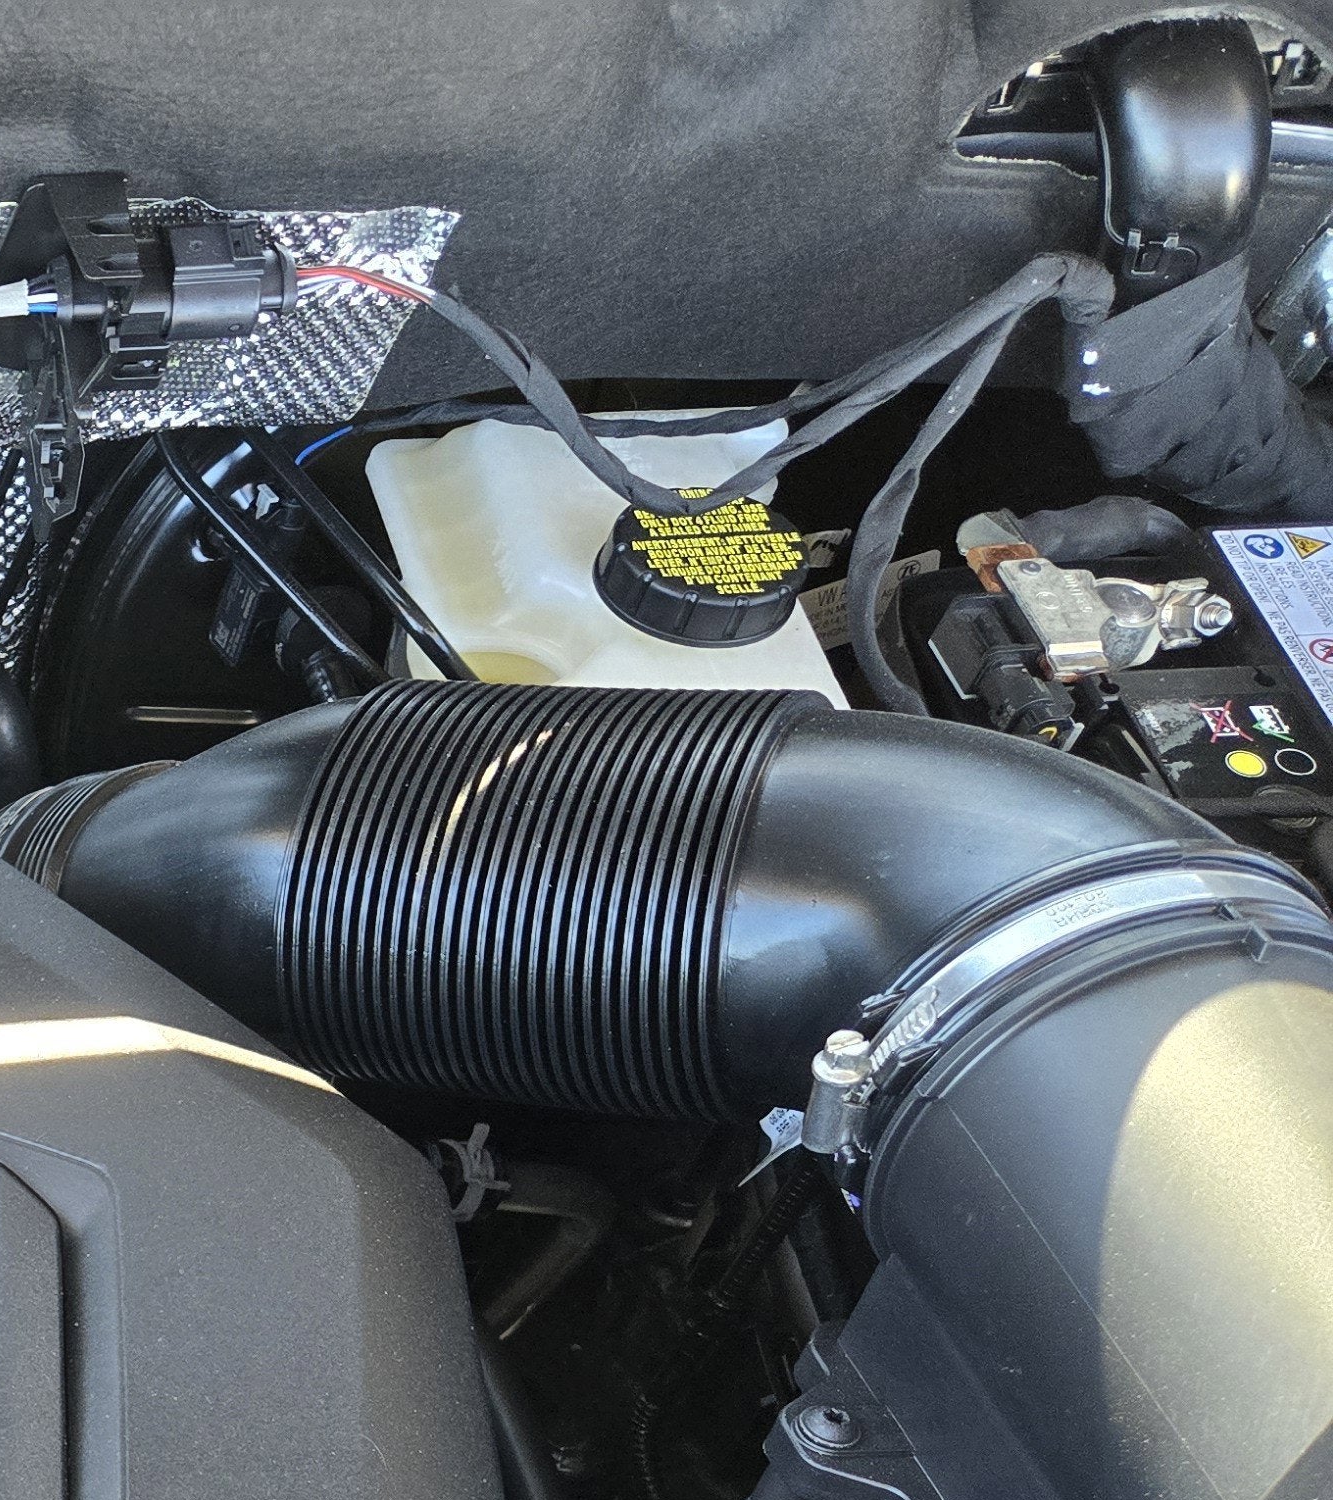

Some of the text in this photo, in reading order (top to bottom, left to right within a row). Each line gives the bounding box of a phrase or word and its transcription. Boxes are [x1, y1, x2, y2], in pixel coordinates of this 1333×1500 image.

[741, 504, 766, 514] USE
[640, 518, 668, 528] ONLY
[670, 516, 693, 526] DOT
[703, 514, 738, 525] FLUID
[737, 512, 770, 523] FROM
[649, 528, 659, 537] A
[657, 525, 702, 537] SEALED
[725, 533, 786, 546] NETTOYER
[783, 532, 802, 542] LE
[647, 548, 703, 560] BOUCHON
[705, 546, 741, 557] AVANT
[743, 544, 761, 554] DE
[760, 552, 785, 562] QUE
[785, 550, 803, 561] DU
[660, 567, 705, 578] LIQUIDE
[715, 570, 783, 584] CONTENANT
